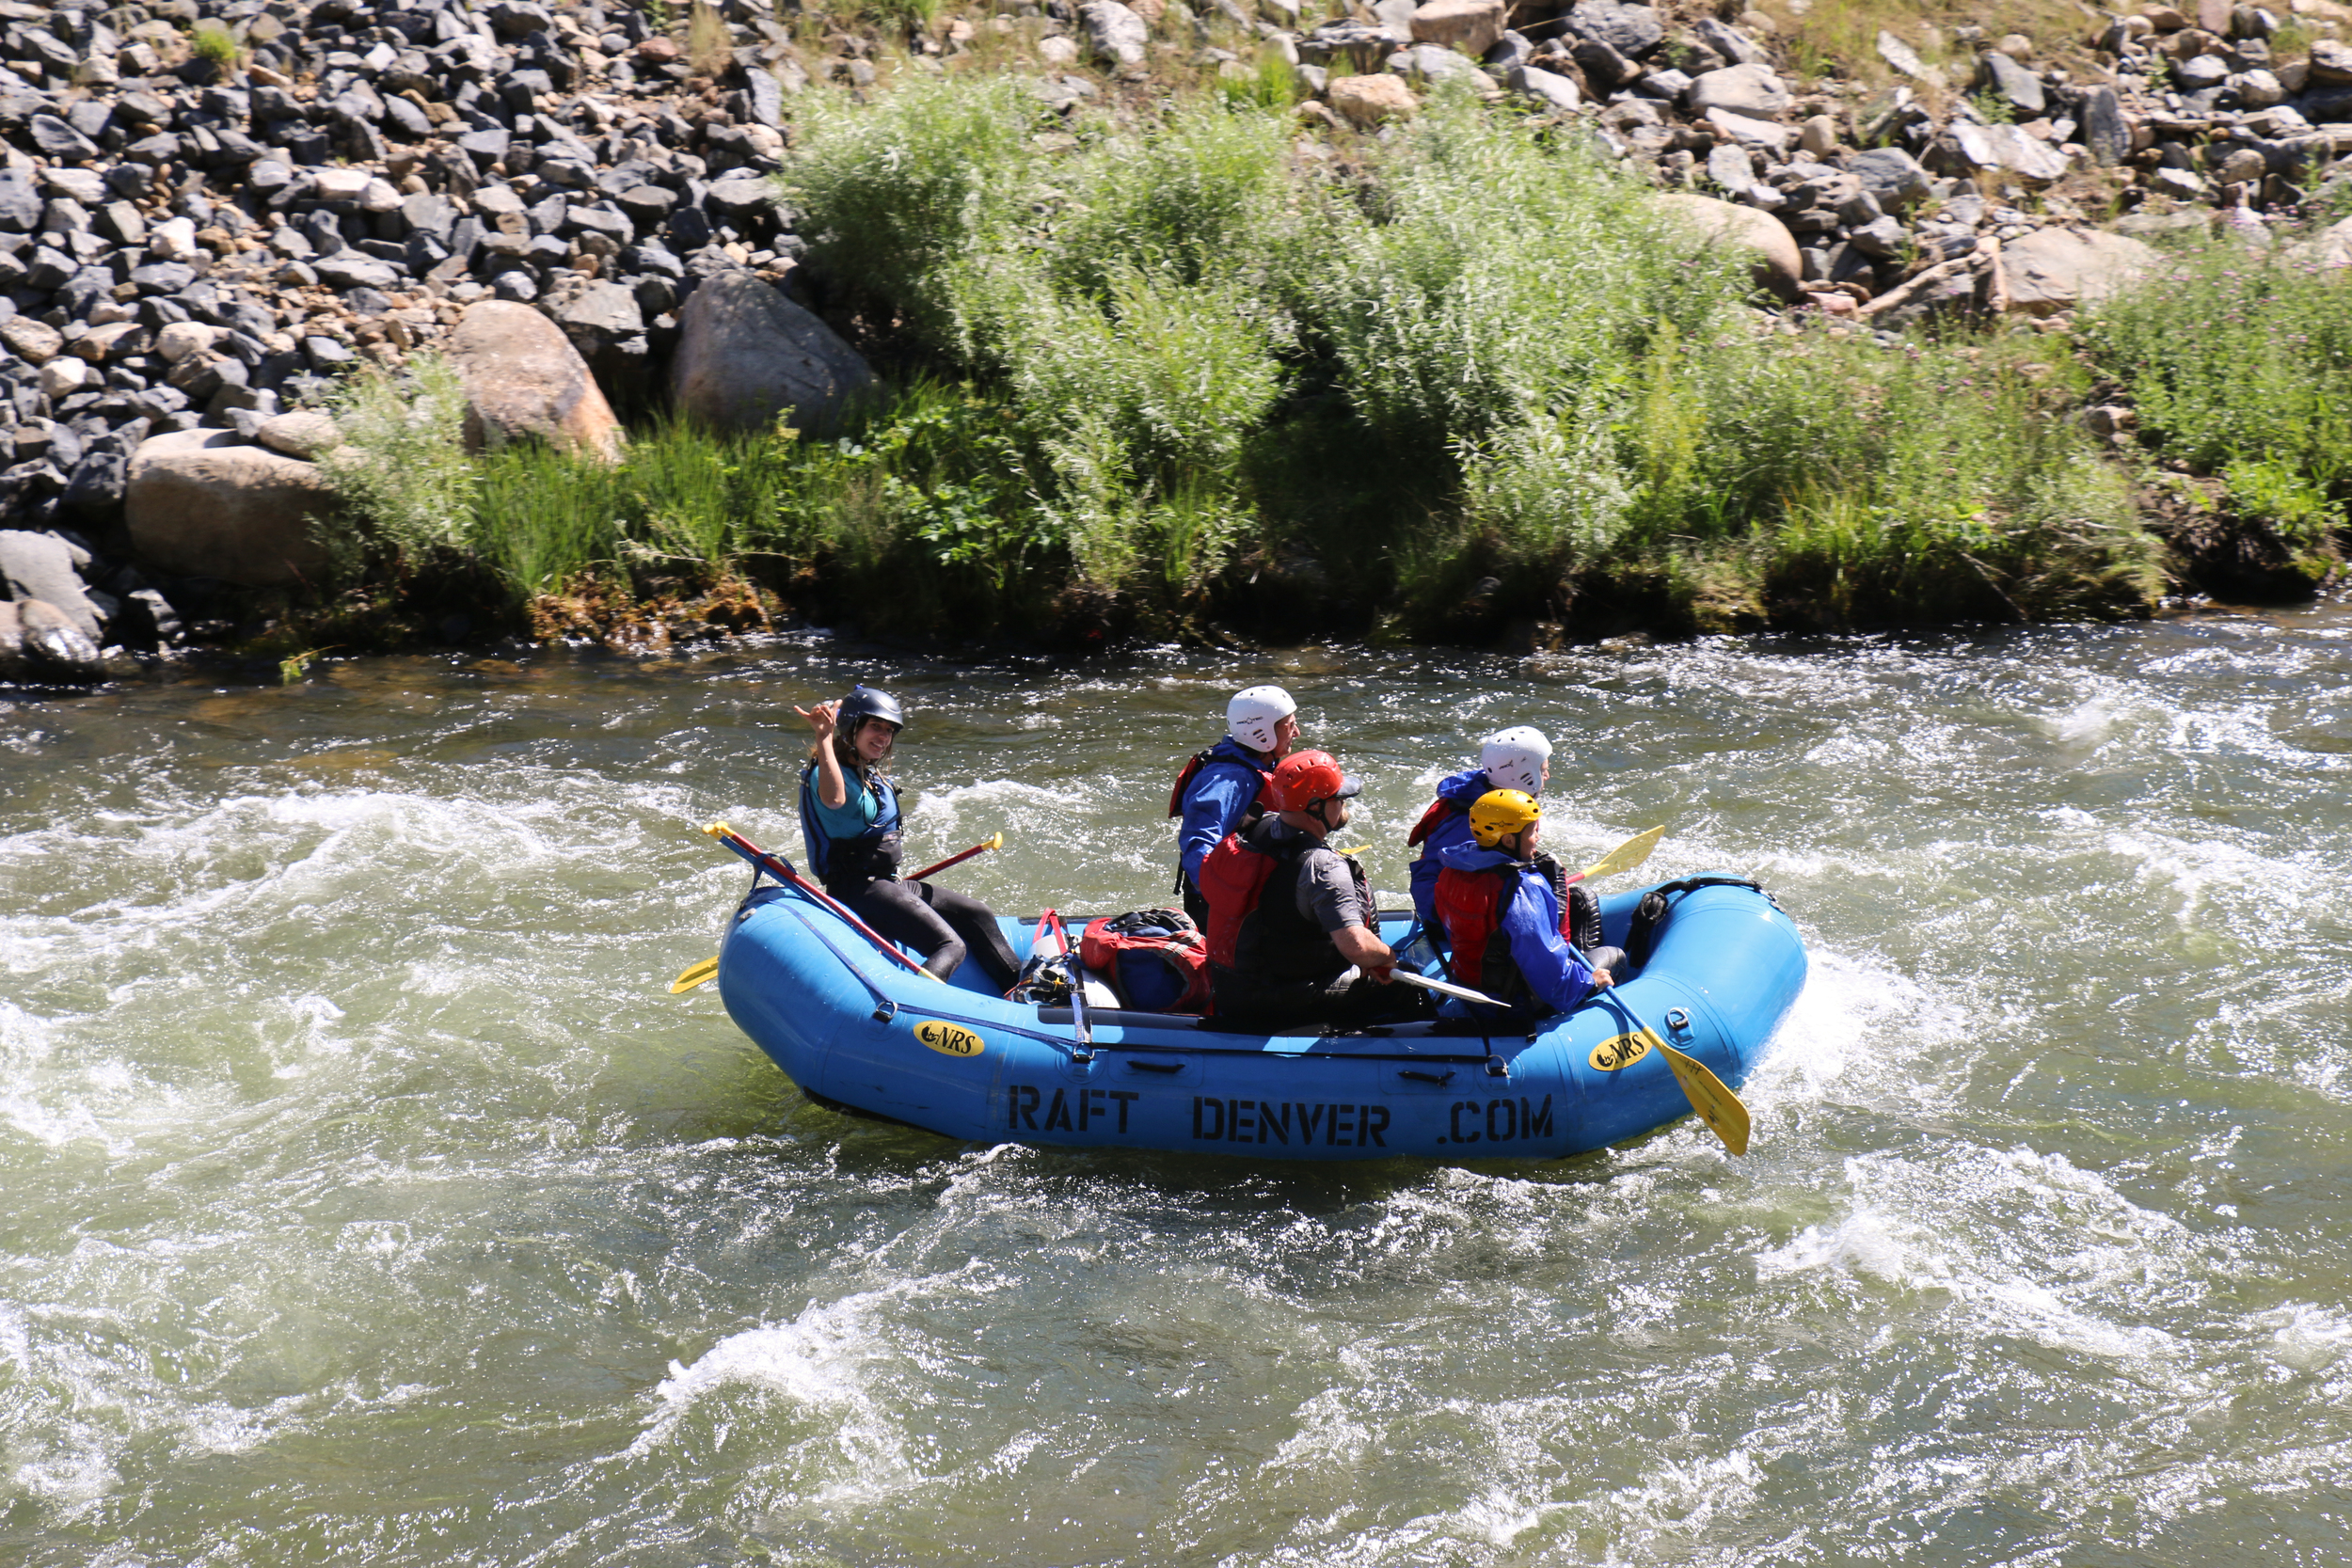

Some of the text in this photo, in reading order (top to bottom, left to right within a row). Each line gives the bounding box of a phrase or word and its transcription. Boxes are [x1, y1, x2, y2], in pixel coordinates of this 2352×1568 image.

[935, 1026, 975, 1054] NRS
[1609, 1034, 1645, 1064] NRS
[1009, 1085, 1553, 1148] RAFT DENVER .COM
